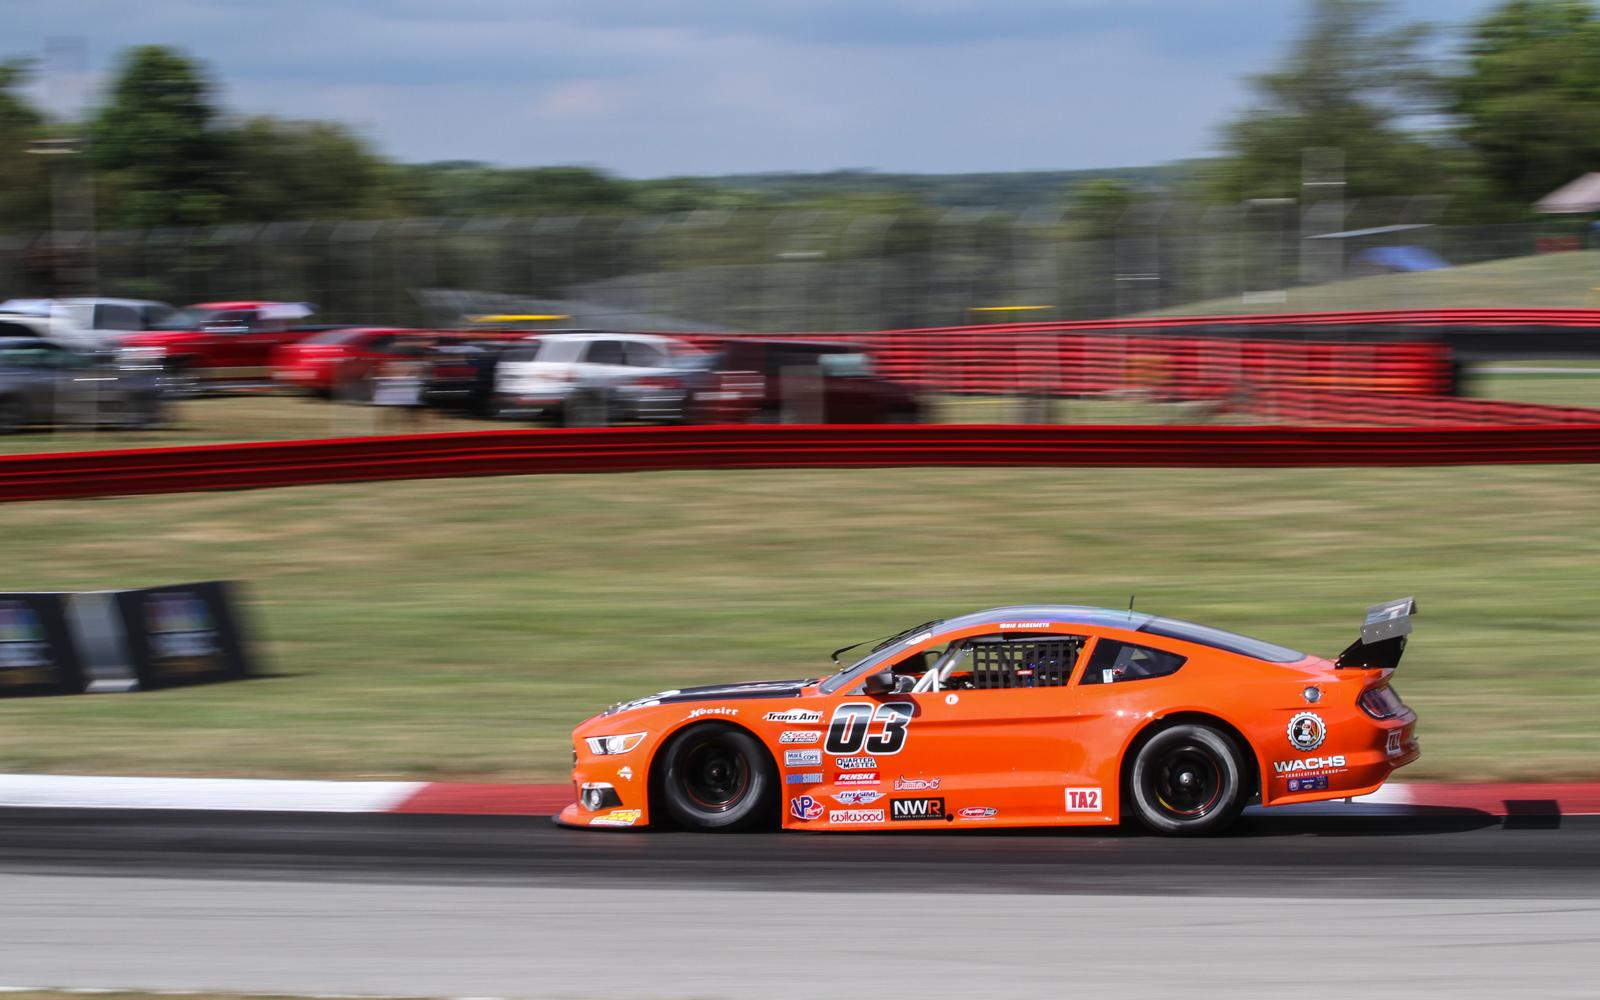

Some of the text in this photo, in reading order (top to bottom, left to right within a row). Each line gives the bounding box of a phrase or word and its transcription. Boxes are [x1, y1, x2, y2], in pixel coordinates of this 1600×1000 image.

[688, 706, 738, 719] Hoosier
[767, 713, 799, 721] Trans
[824, 702, 914, 755] 03
[837, 757, 873, 765] QUARTER
[1274, 755, 1346, 773] WACHS
[838, 773, 876, 781] PENSKE
[791, 796, 813, 818] VP
[1069, 791, 1098, 808] TA2
[894, 800, 941, 815] NWR
